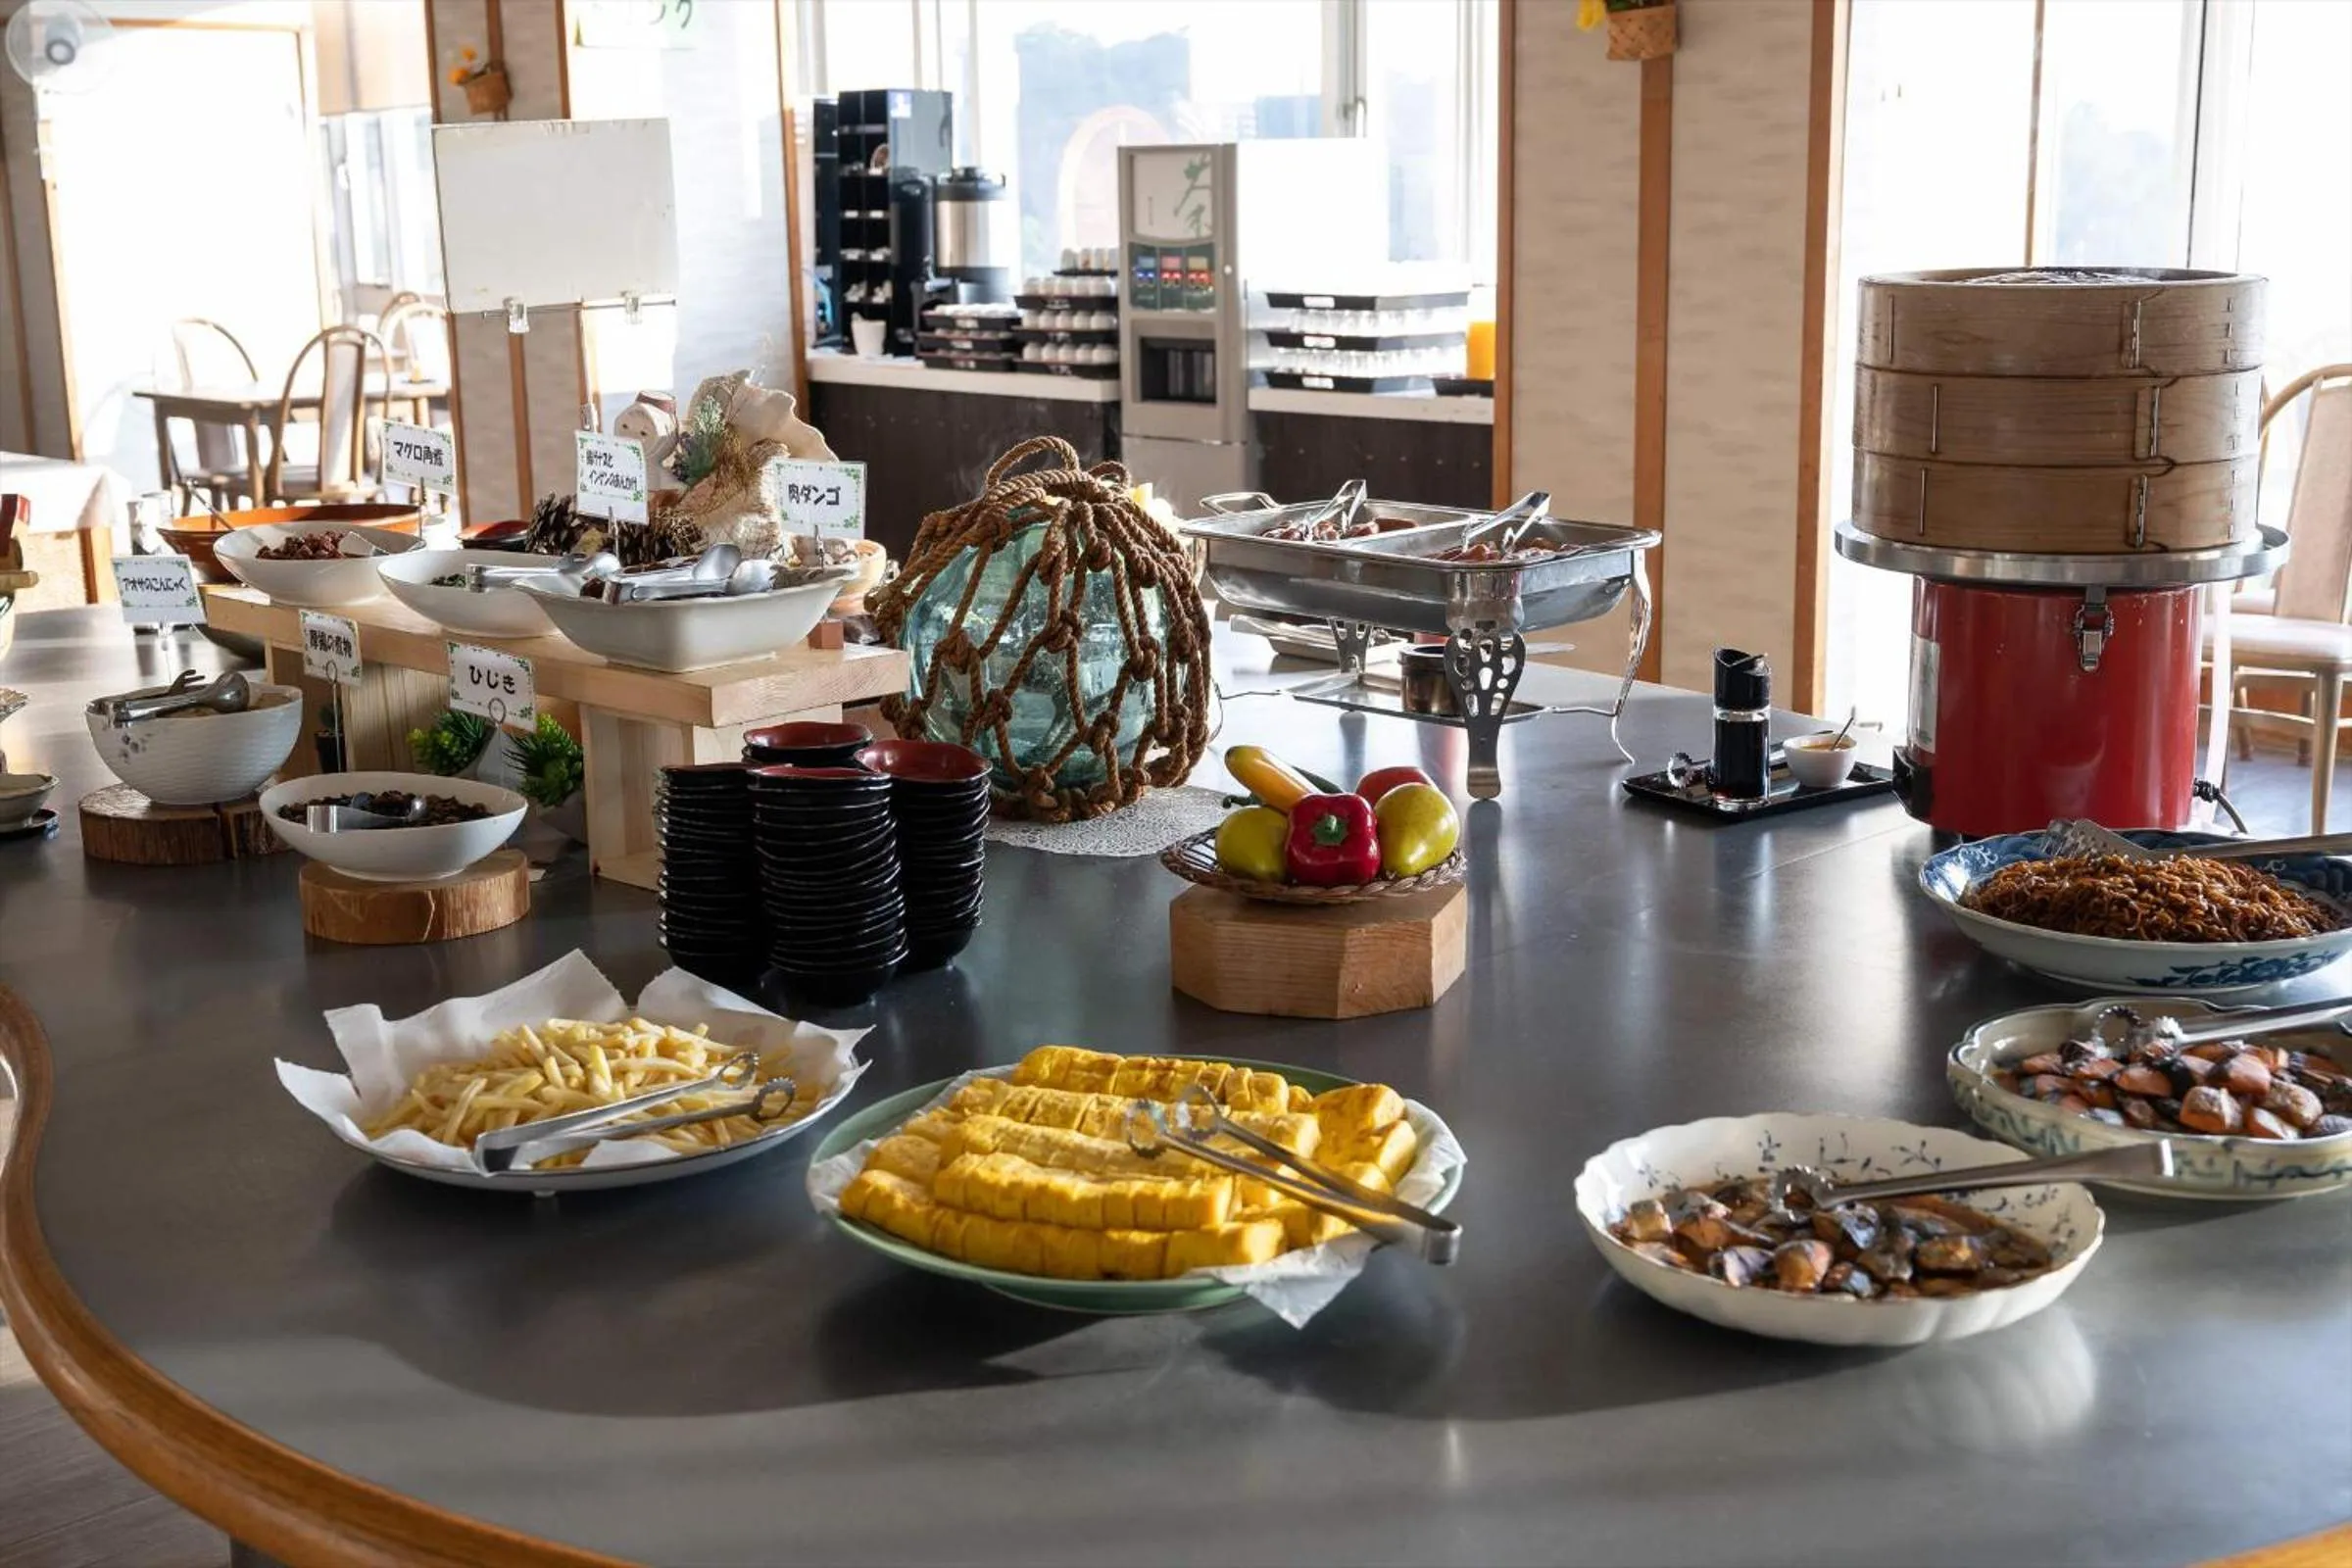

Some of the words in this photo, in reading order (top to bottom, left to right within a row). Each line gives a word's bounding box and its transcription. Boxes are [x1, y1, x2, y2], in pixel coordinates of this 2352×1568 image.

[393, 440, 444, 467] マグロ角煮
[788, 482, 841, 505] 肉ダンゴ
[469, 664, 515, 695] ひじき
